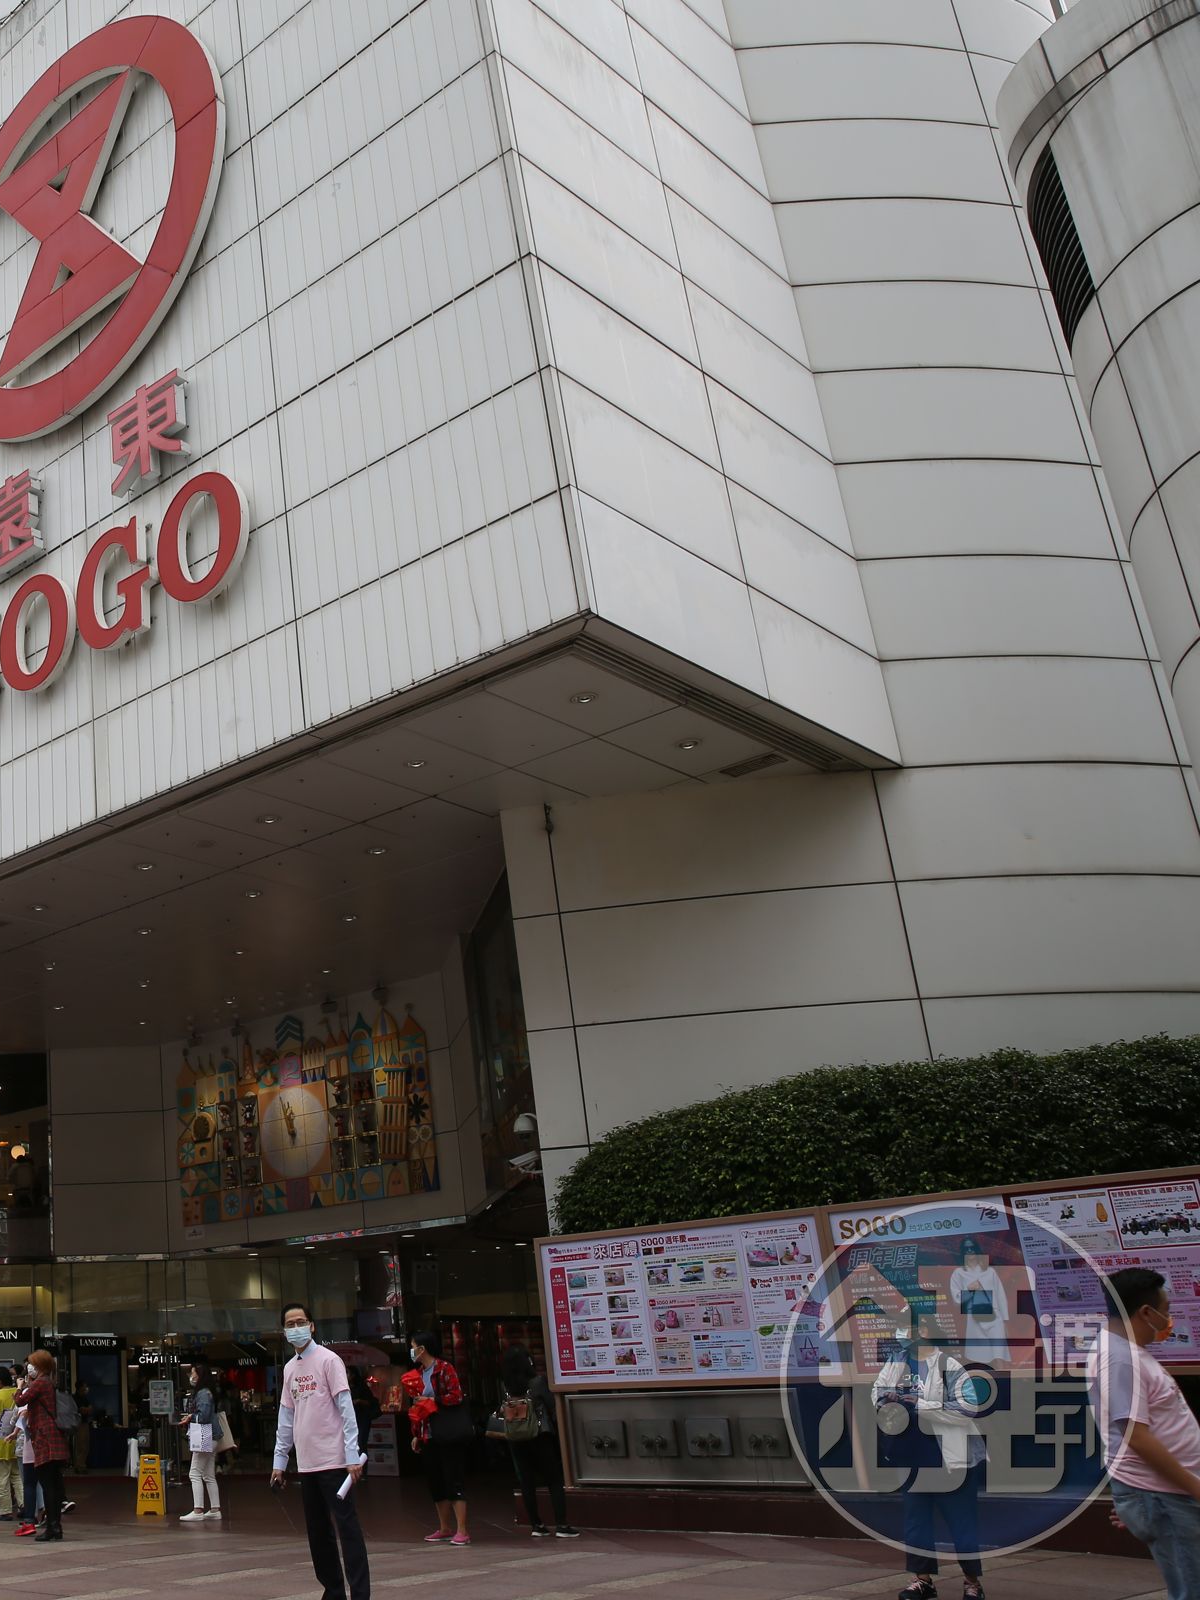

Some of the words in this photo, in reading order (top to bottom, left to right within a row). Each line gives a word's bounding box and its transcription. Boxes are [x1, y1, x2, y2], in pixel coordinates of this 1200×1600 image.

[839, 1214, 907, 1239] SOGO
[593, 1240, 638, 1260] 來店禮
[641, 1236, 665, 1247] SOGO
[665, 1234, 687, 1245] 週年慶
[847, 1244, 918, 1271] 週年慶
